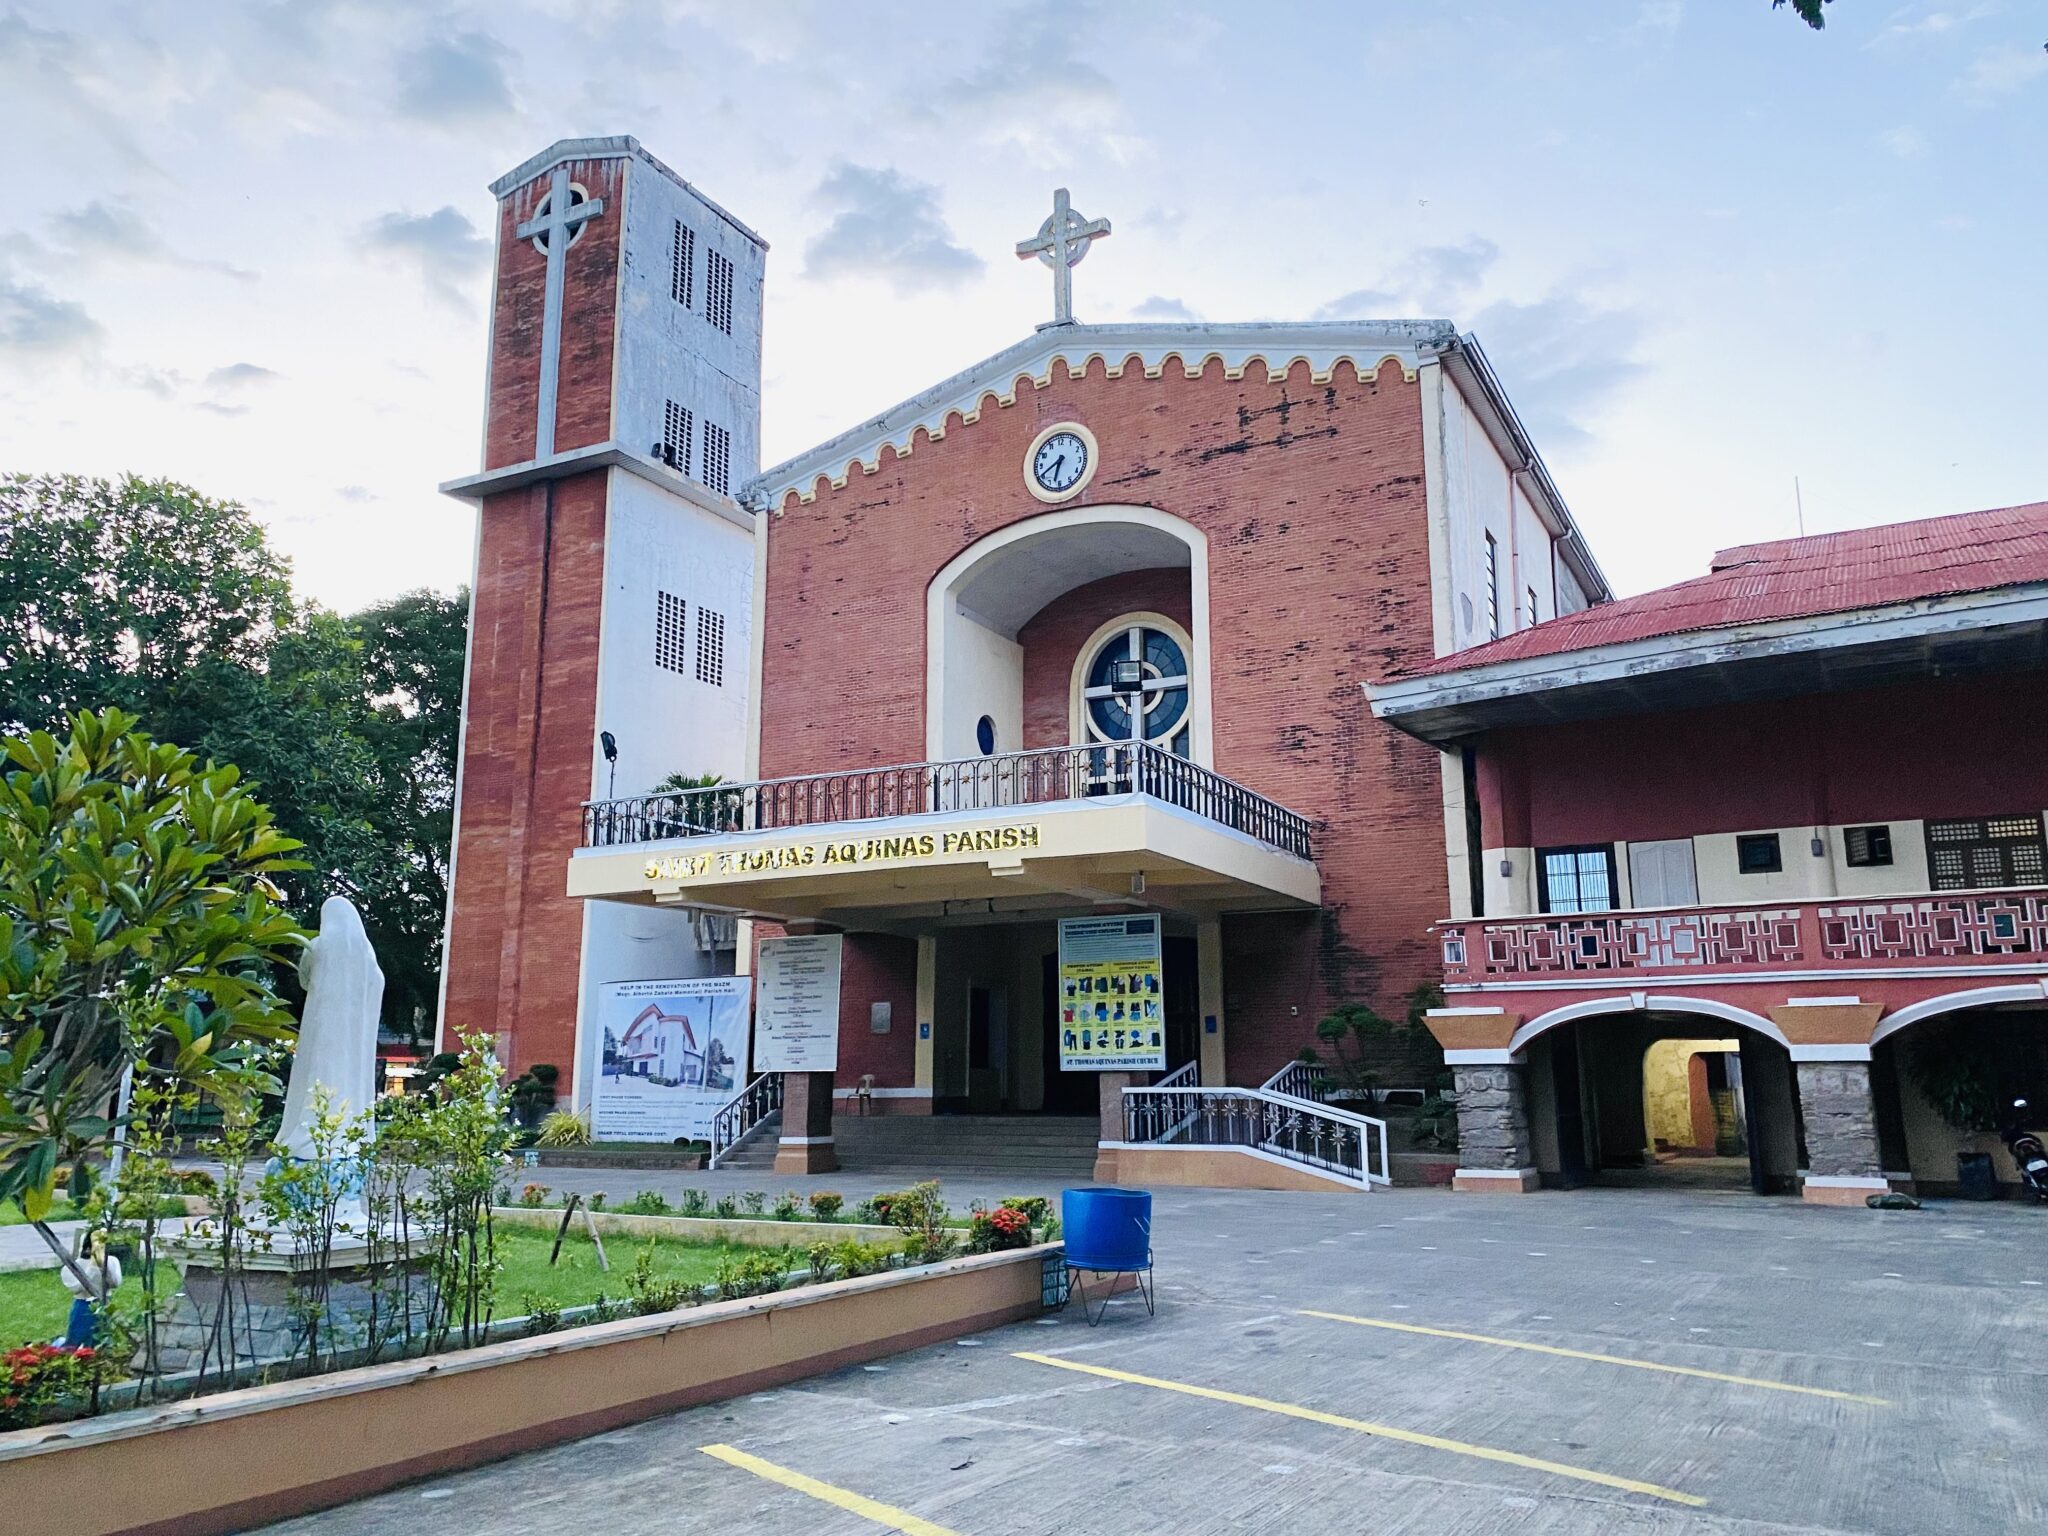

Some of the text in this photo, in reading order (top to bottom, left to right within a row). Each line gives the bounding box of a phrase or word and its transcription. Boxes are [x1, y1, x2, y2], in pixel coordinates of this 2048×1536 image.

[1057, 438, 1064, 446] 12
[644, 823, 1041, 880] SAINT THOMAS AQUINAS PARISH
